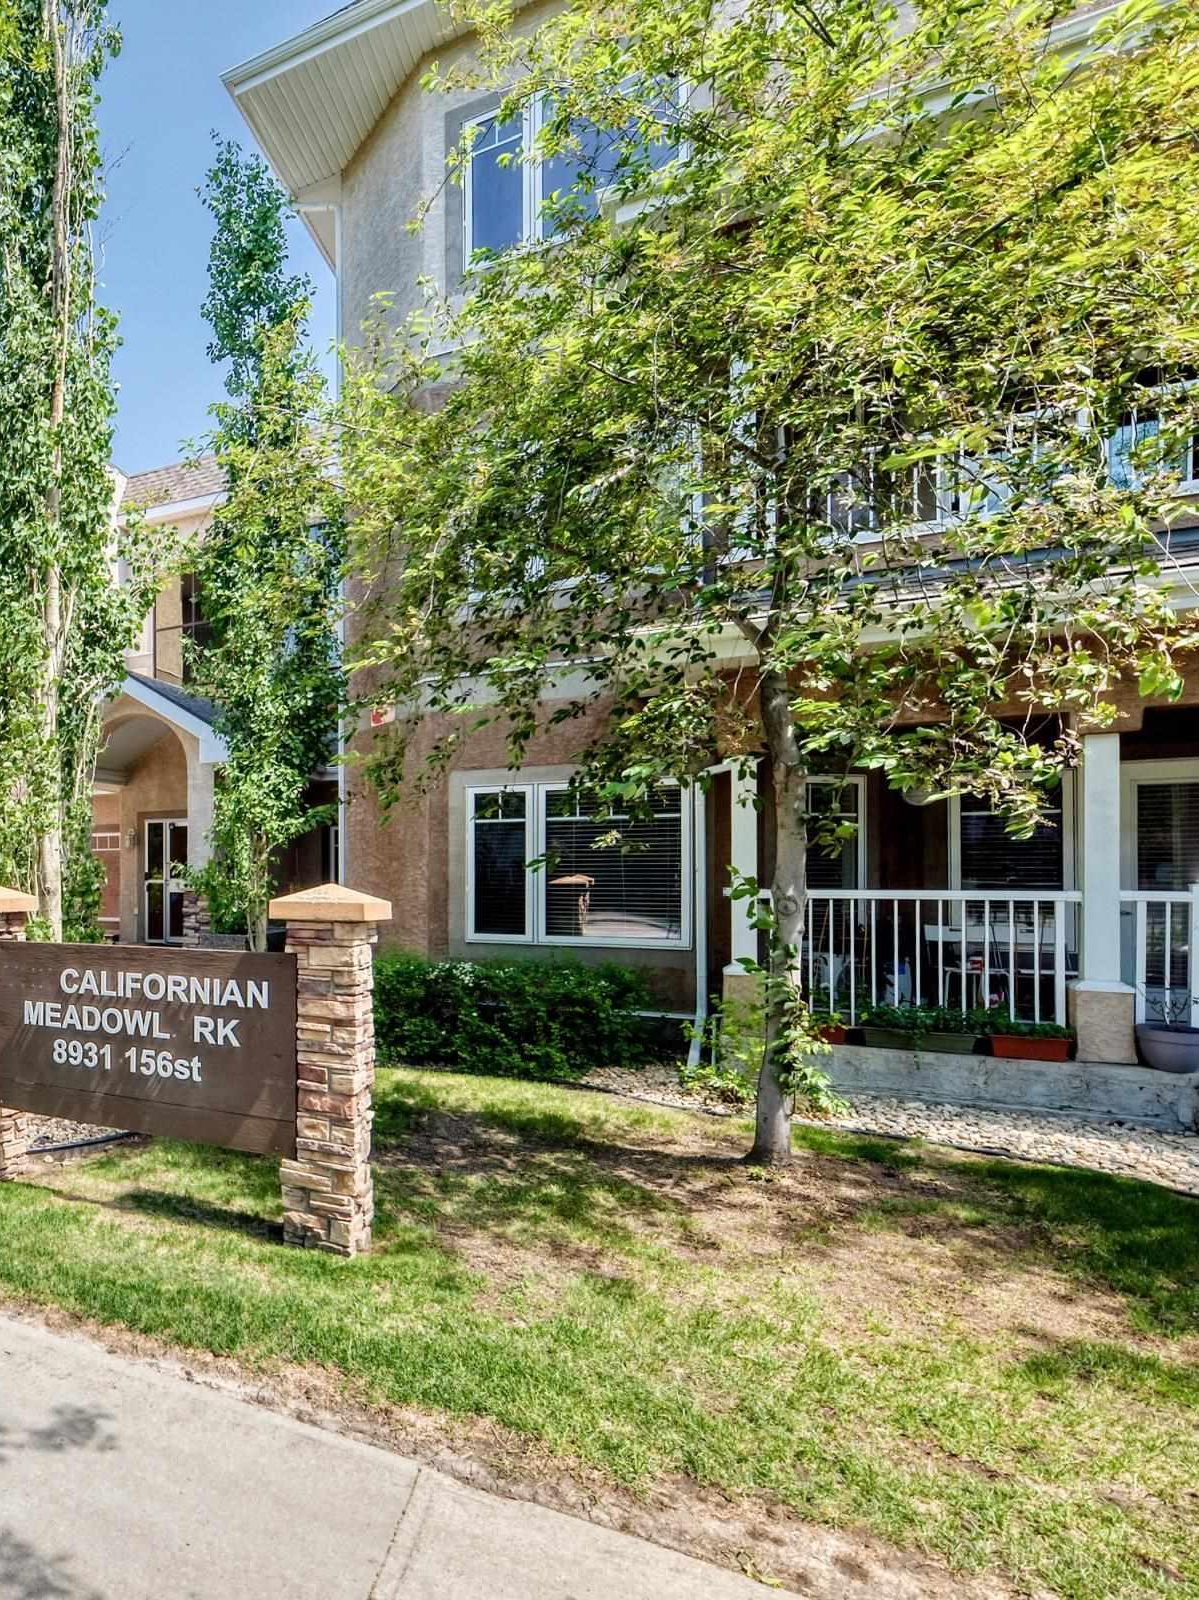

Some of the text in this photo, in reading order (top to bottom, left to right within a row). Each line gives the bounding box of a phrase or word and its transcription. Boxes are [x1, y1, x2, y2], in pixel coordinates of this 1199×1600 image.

[59, 968, 269, 1009] CALIFORNIAN
[53, 1039, 202, 1082] 8931 156st
